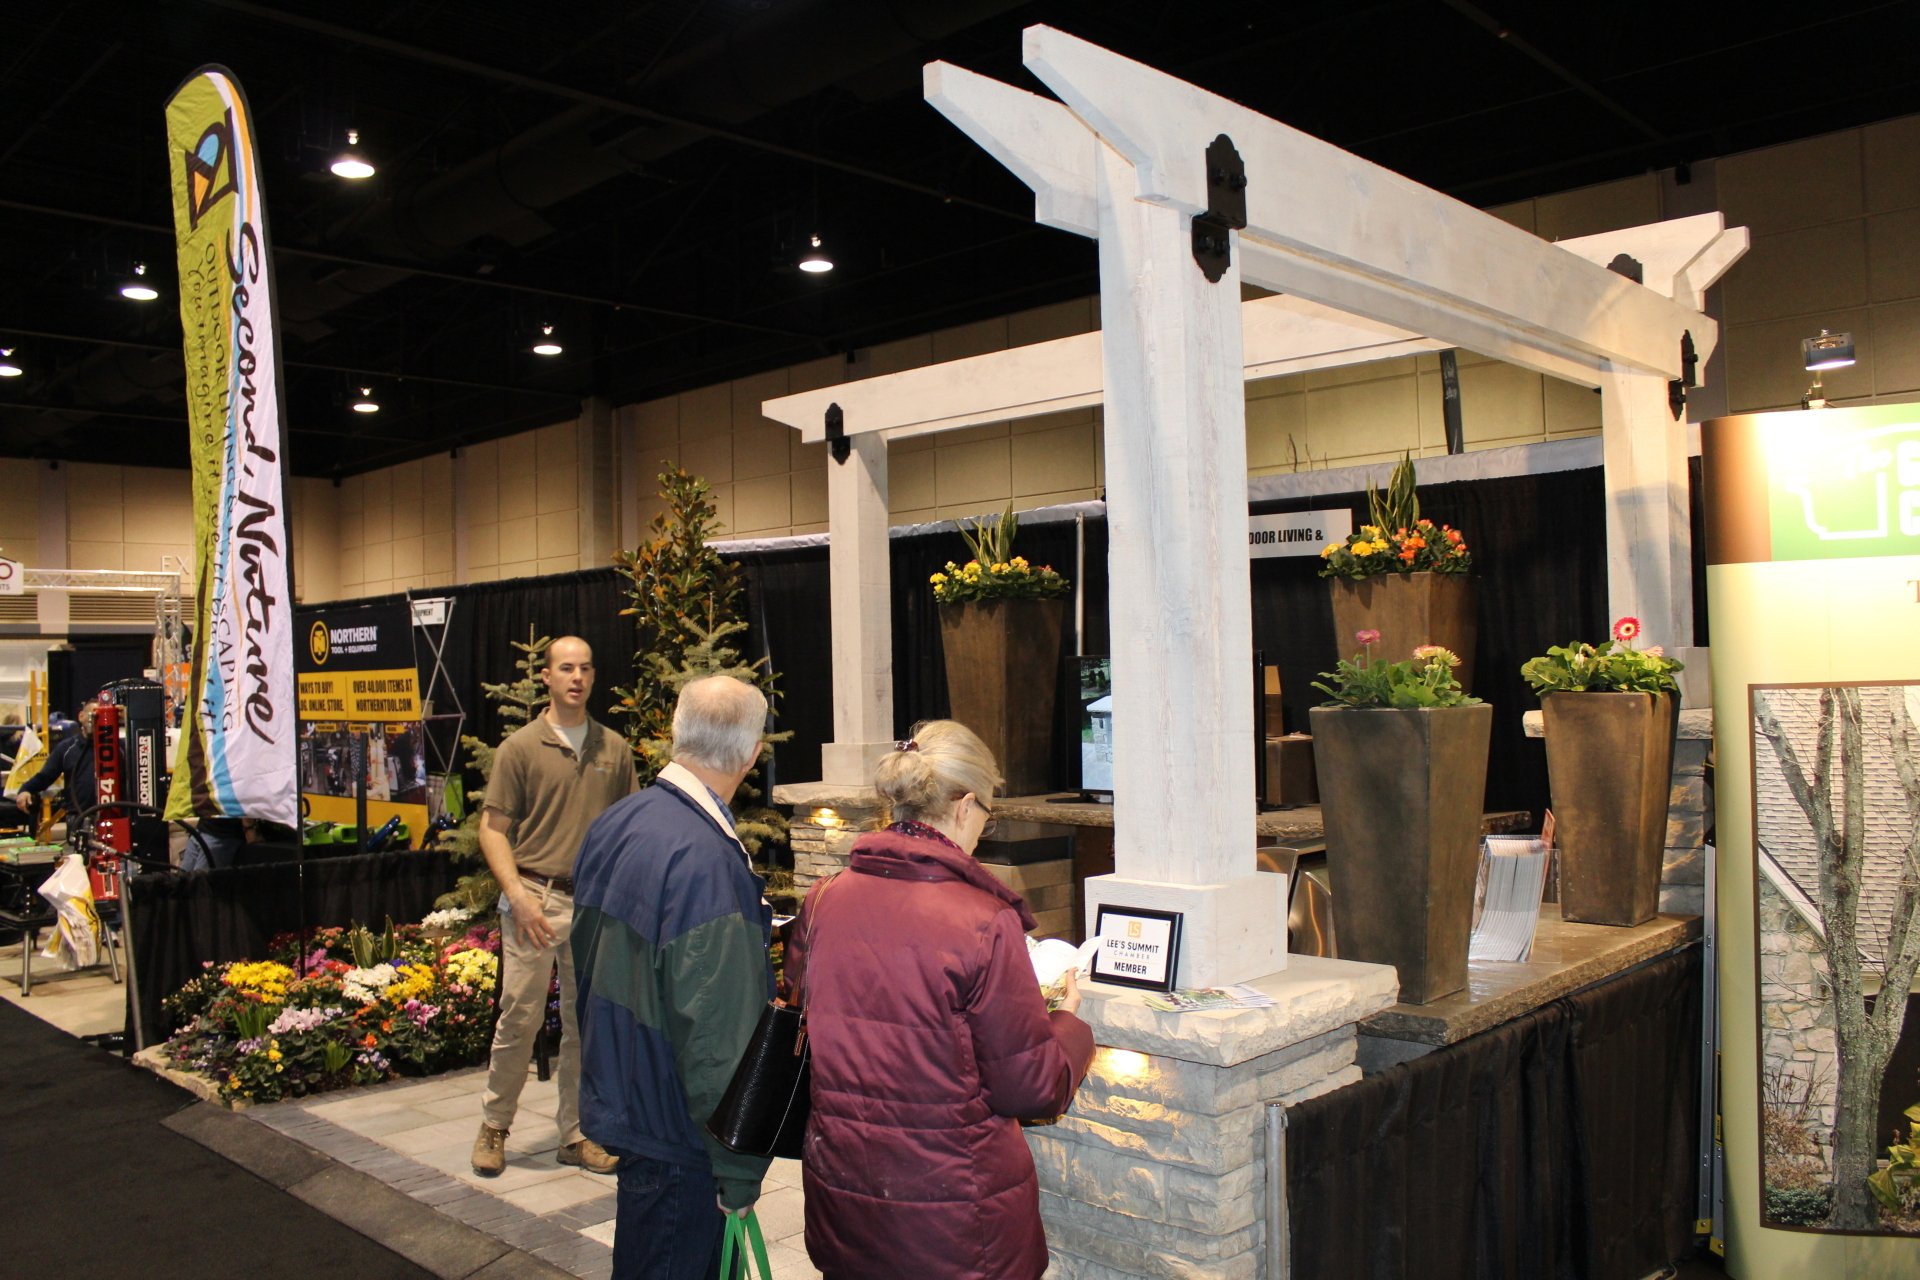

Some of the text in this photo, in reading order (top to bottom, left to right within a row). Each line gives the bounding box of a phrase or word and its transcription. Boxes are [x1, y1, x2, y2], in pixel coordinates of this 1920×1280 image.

[187, 258, 205, 313] You
[205, 243, 227, 385] OUTDOOR
[218, 389, 236, 485] LIVING
[195, 322, 214, 447] imagine
[226, 221, 279, 745] Second Nature
[1278, 528, 1312, 543] LIVING
[1315, 529, 1323, 541] &
[330, 626, 377, 644] NORTHERN
[331, 646, 344, 654] TOOL
[348, 644, 377, 653] EQUIPMENT
[314, 681, 321, 693] TO
[353, 681, 366, 693] OVER
[387, 679, 404, 692] ITEMS
[405, 678, 412, 692] AT
[356, 698, 412, 712] NORTHERNTOOL.COM
[99, 725, 116, 776] TON
[1107, 939, 1159, 953] LEE'S SUMMIT
[1113, 950, 1150, 960] CHAMBER
[1114, 962, 1147, 975] MEMBER
